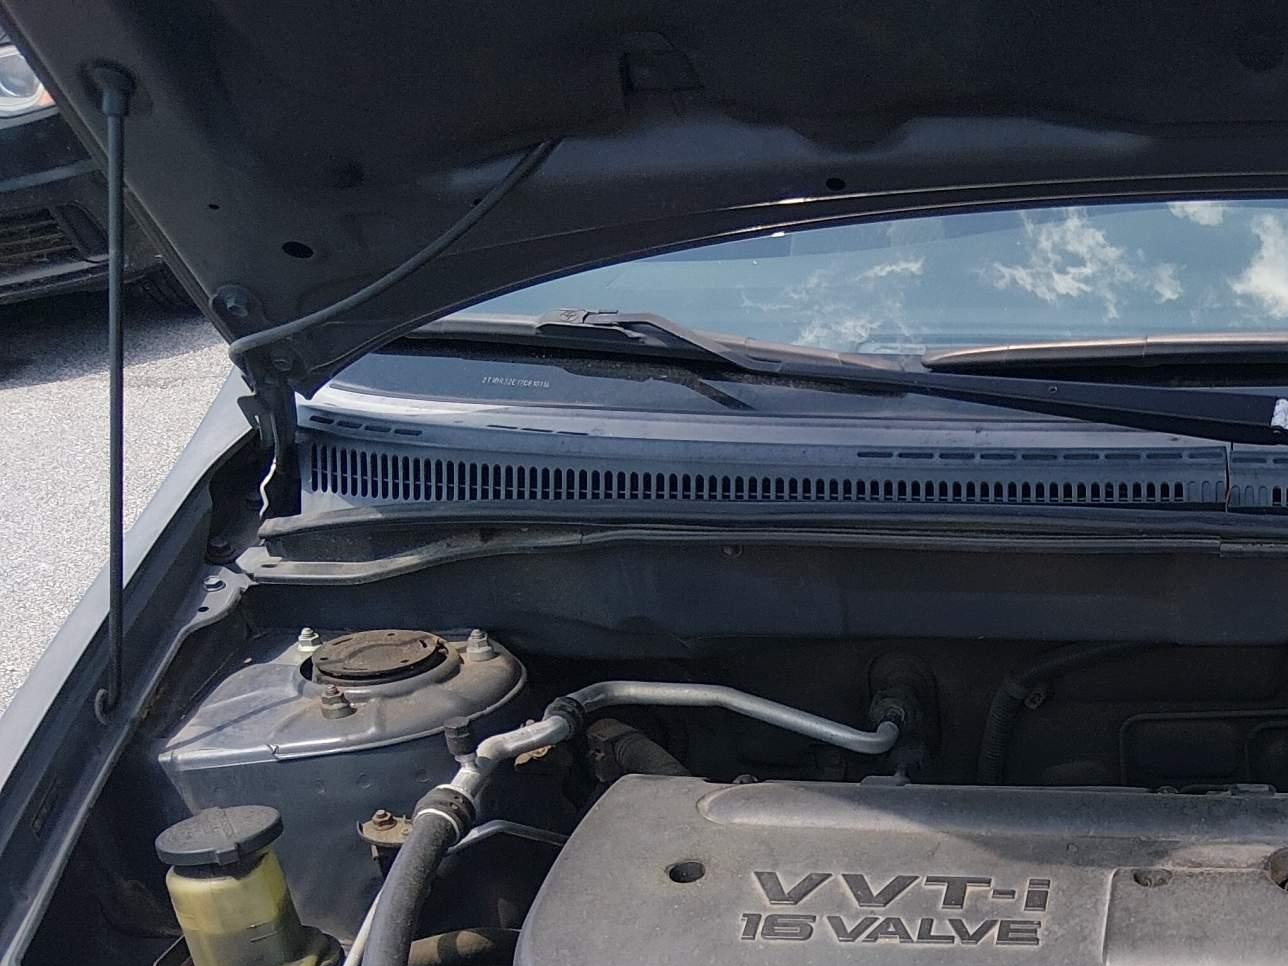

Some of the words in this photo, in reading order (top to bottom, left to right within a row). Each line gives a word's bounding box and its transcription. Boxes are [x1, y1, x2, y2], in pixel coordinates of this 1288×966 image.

[752, 871, 1051, 911] VVT-i
[740, 913, 817, 941] 16
[826, 915, 1042, 945] VALVE
